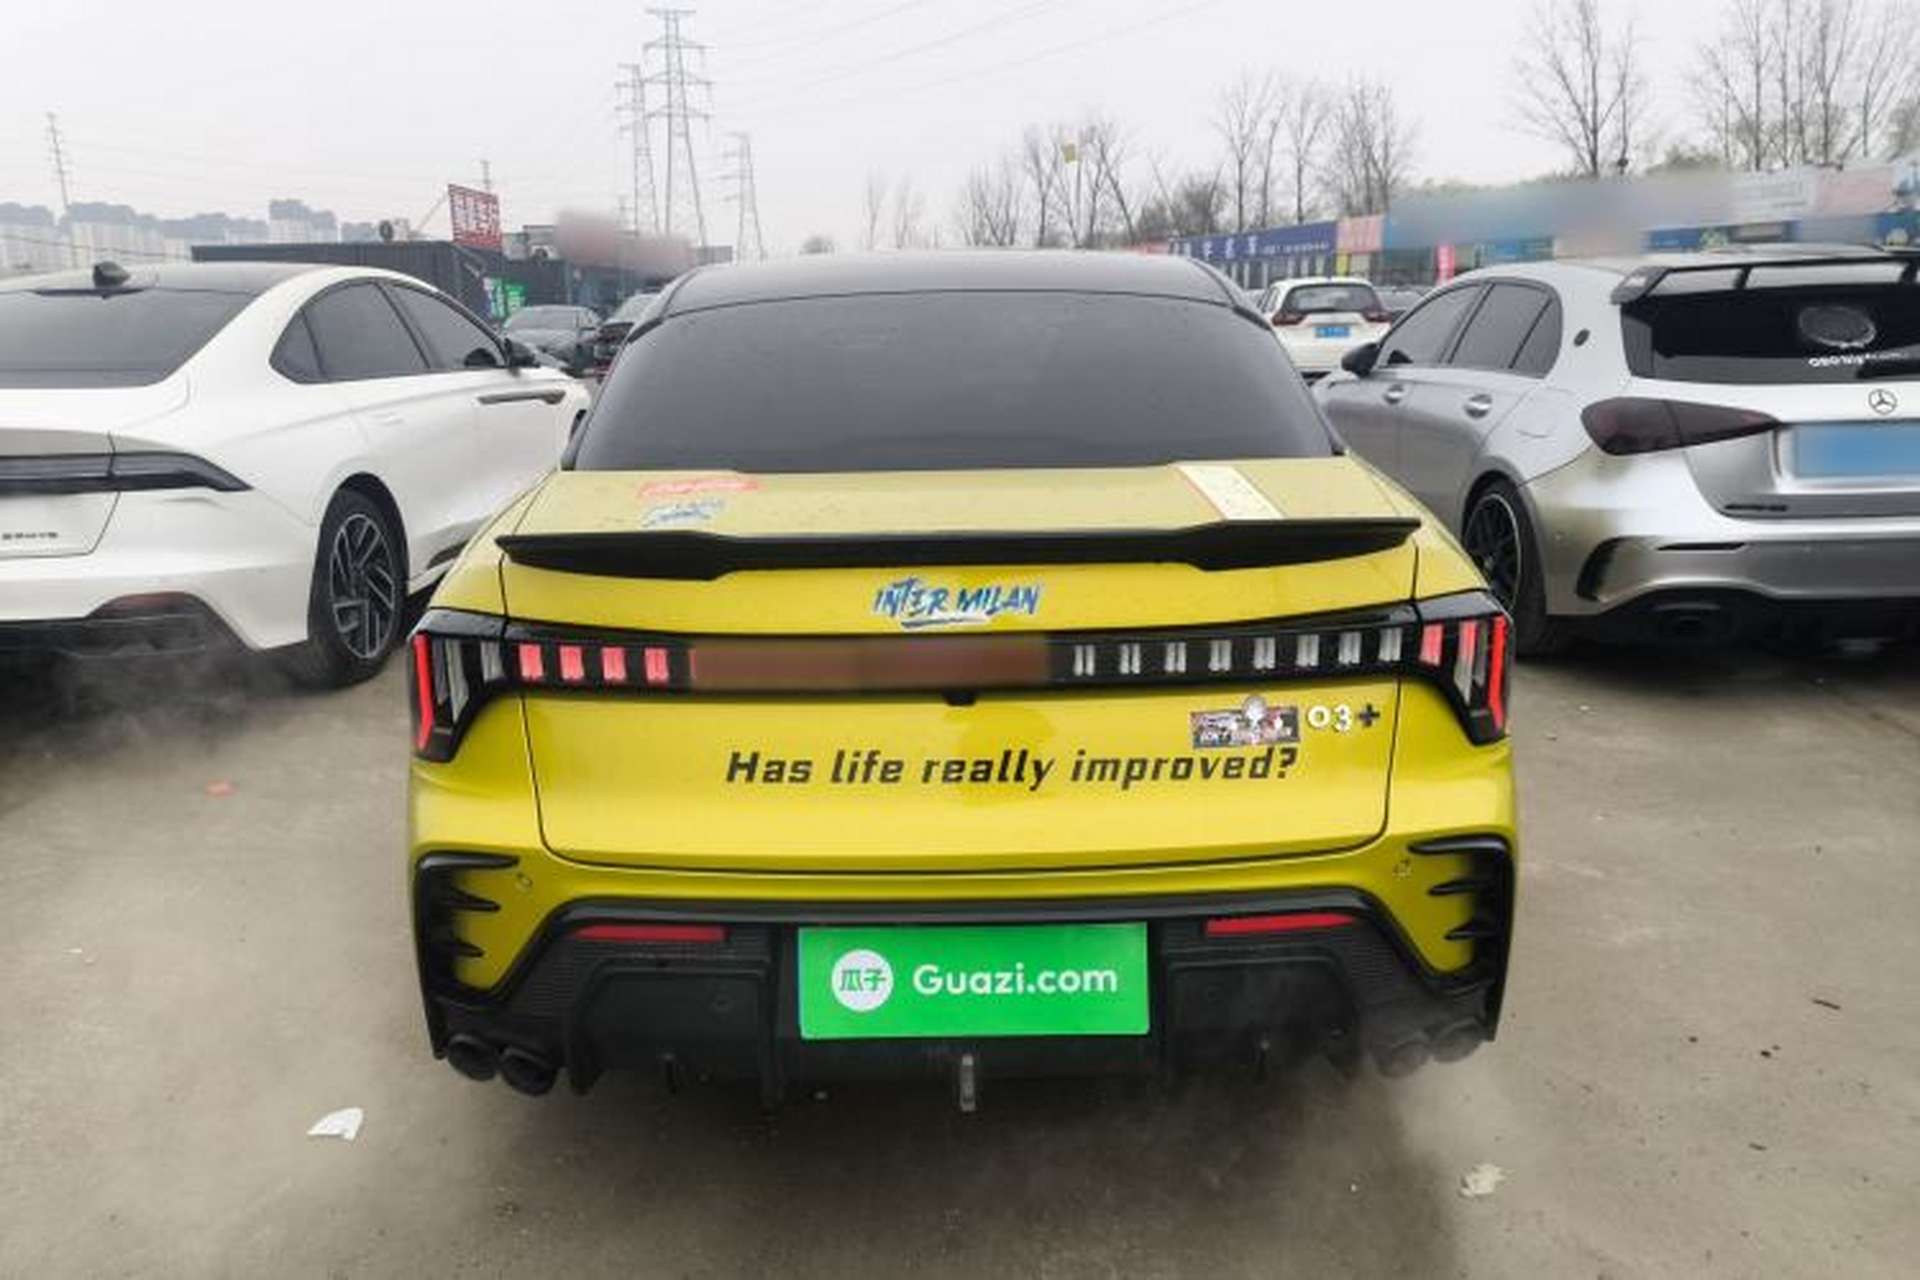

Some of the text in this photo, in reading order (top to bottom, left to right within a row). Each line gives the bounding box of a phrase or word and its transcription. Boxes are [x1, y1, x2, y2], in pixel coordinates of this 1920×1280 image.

[873, 577, 1041, 617] INTER MILAN
[726, 747, 1297, 791] Has life really improved?
